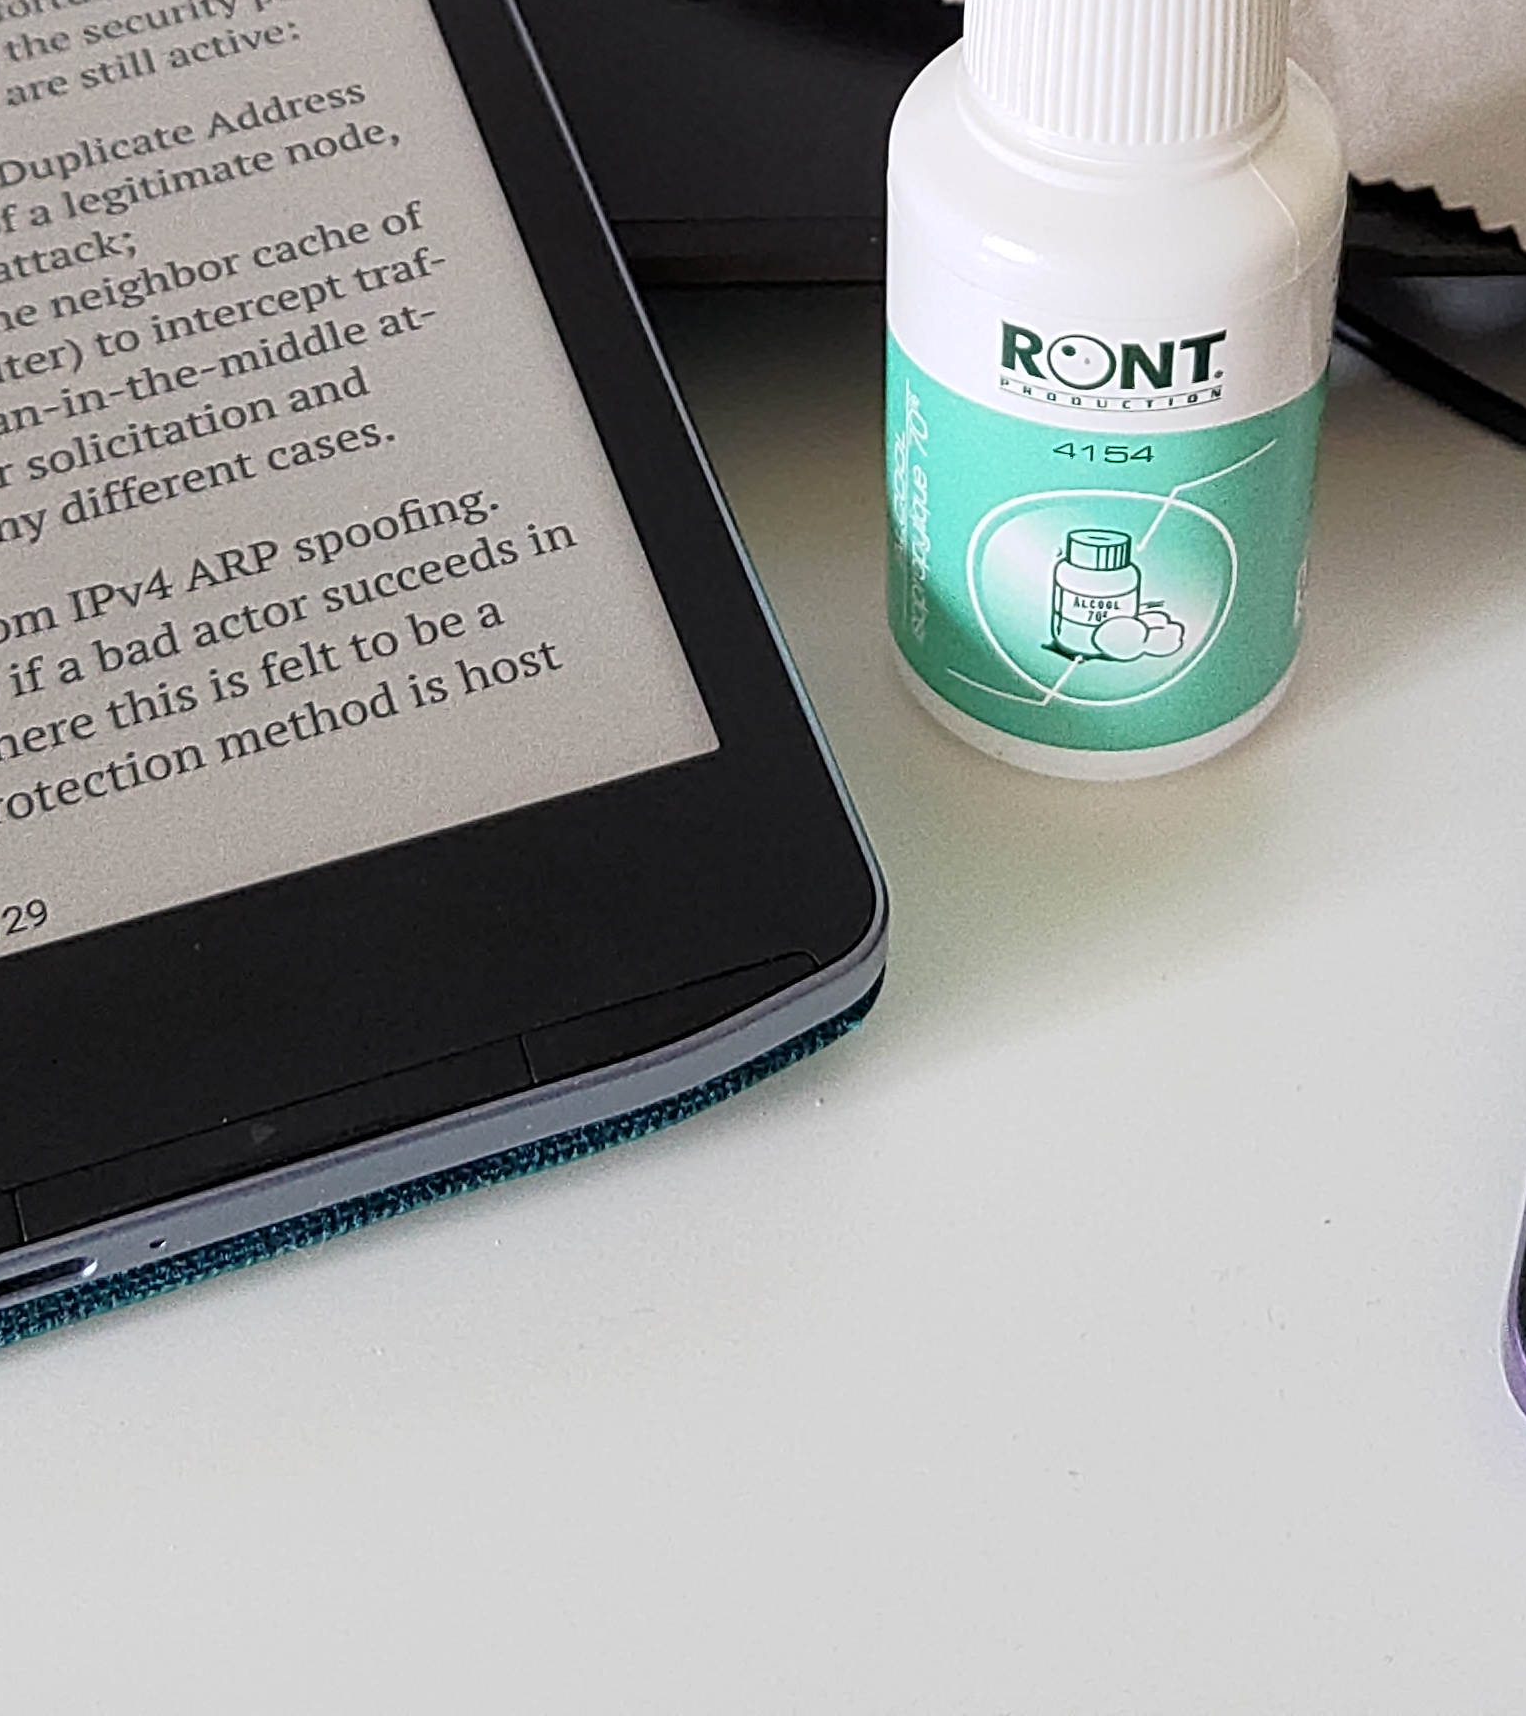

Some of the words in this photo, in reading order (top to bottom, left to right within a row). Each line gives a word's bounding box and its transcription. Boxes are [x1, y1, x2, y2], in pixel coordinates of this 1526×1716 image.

[5, 75, 69, 108] are
[78, 47, 158, 90] still
[206, 83, 367, 141] Address
[28, 205, 53, 228] a
[60, 151, 275, 220] legitimate
[283, 122, 401, 167] node,
[48, 253, 241, 320] neighbor
[251, 222, 371, 269] cache
[380, 199, 423, 237] of
[92, 329, 141, 359] to
[149, 274, 348, 346] intercept
[351, 246, 446, 293] traf-
[377, 306, 437, 338] at-
[1001, 319, 1227, 390] RONT
[25, 398, 279, 482] solicitation
[286, 365, 371, 414] and
[1001, 378, 1223, 410] PRODUCTION
[59, 453, 258, 526] different
[266, 423, 396, 472] cases.
[1053, 442, 1155, 464] 4154
[66, 567, 174, 624] IPv4
[185, 540, 279, 594] ARP
[292, 489, 500, 567] spoofing.
[1073, 596, 1121, 610] ALCOOL
[9, 654, 46, 699] if
[56, 657, 86, 686] a
[91, 621, 182, 675] bad
[192, 594, 308, 649] actor
[321, 536, 520, 614] succeeds
[526, 523, 578, 558] in
[105, 681, 199, 732] this
[208, 668, 250, 704] is
[258, 641, 343, 690] felt
[348, 631, 399, 664] to
[404, 612, 466, 647] be
[476, 602, 506, 630] a
[215, 680, 400, 764] method
[407, 673, 449, 710] is
[454, 641, 564, 696] host
